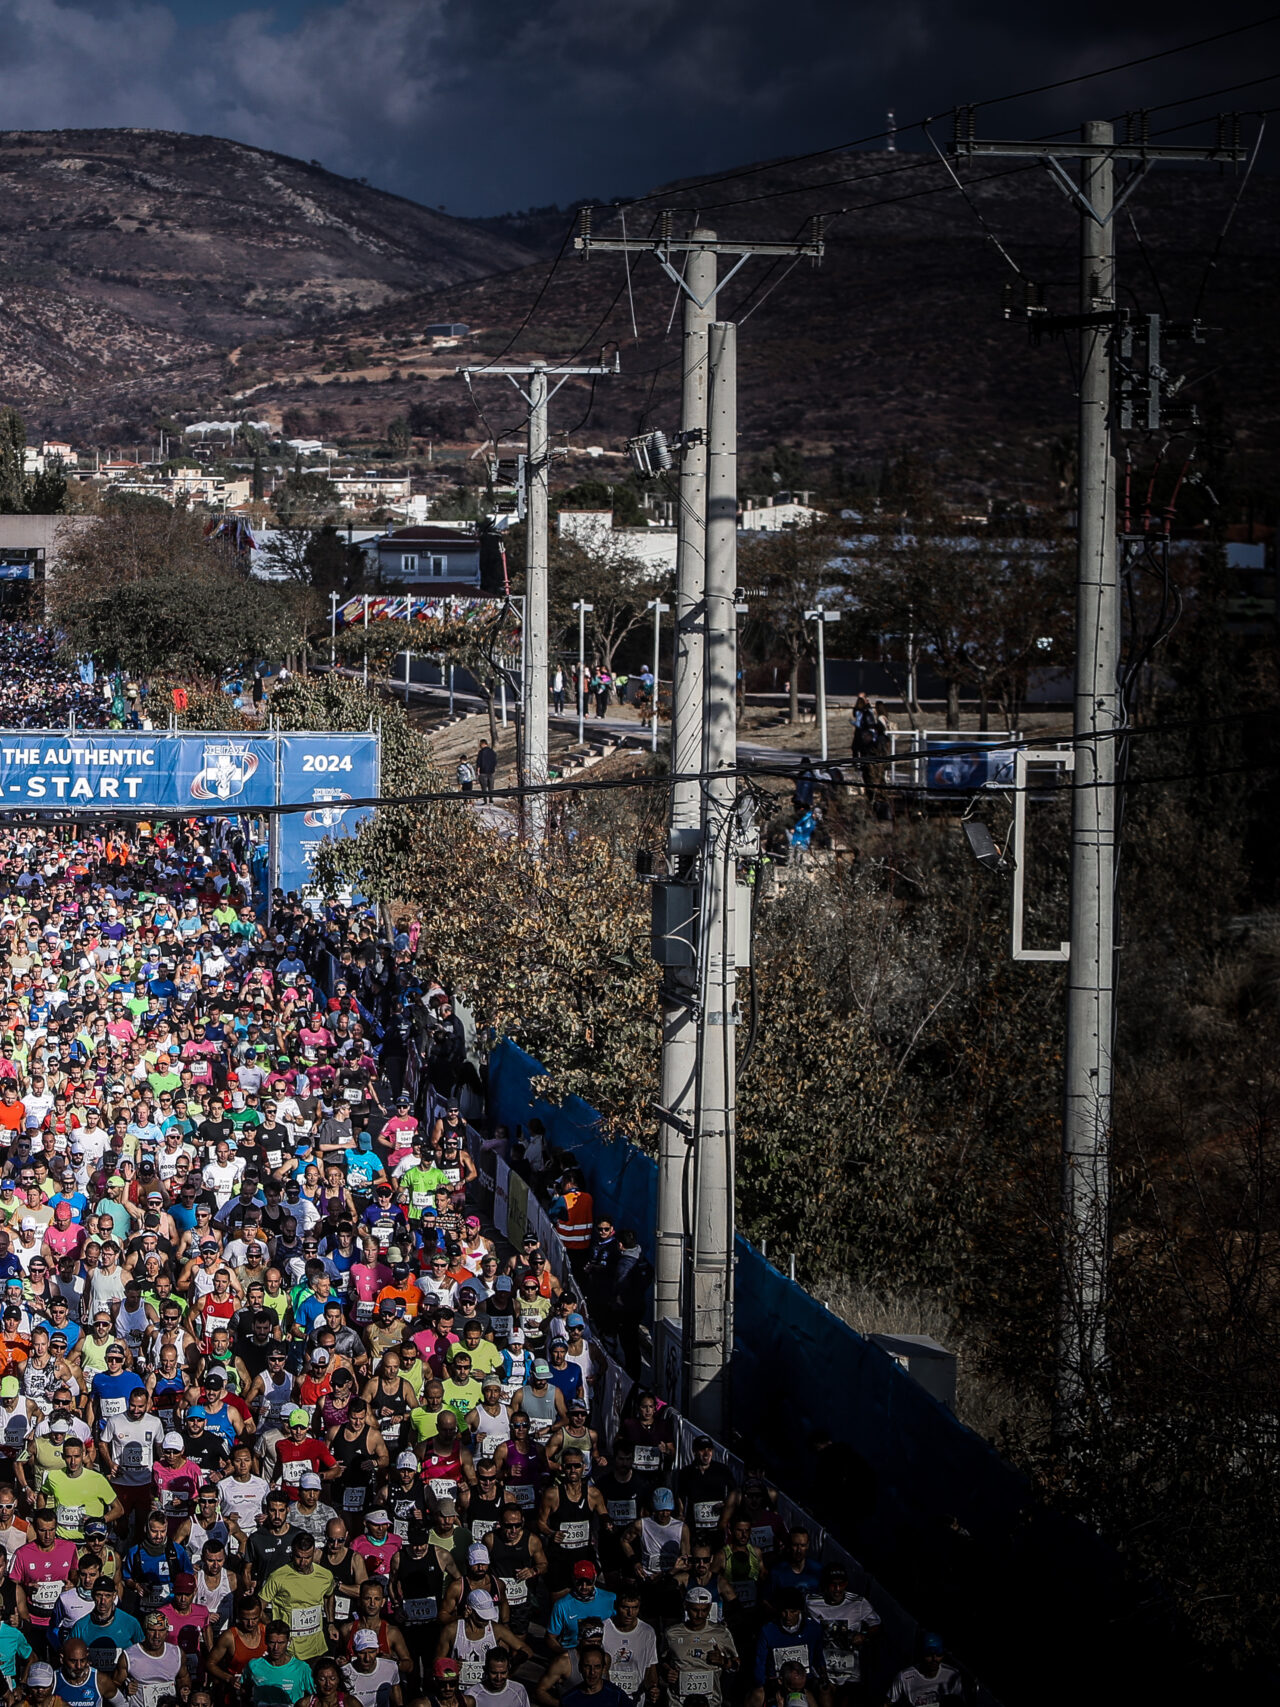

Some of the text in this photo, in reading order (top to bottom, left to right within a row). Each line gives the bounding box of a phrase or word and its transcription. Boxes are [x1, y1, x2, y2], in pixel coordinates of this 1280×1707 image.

[2, 748, 40, 765] THE
[44, 748, 154, 766] AUTHENTIC
[302, 755, 352, 772] 2024
[40, 1591, 58, 1599] 1573
[687, 1682, 707, 1691] 2373
